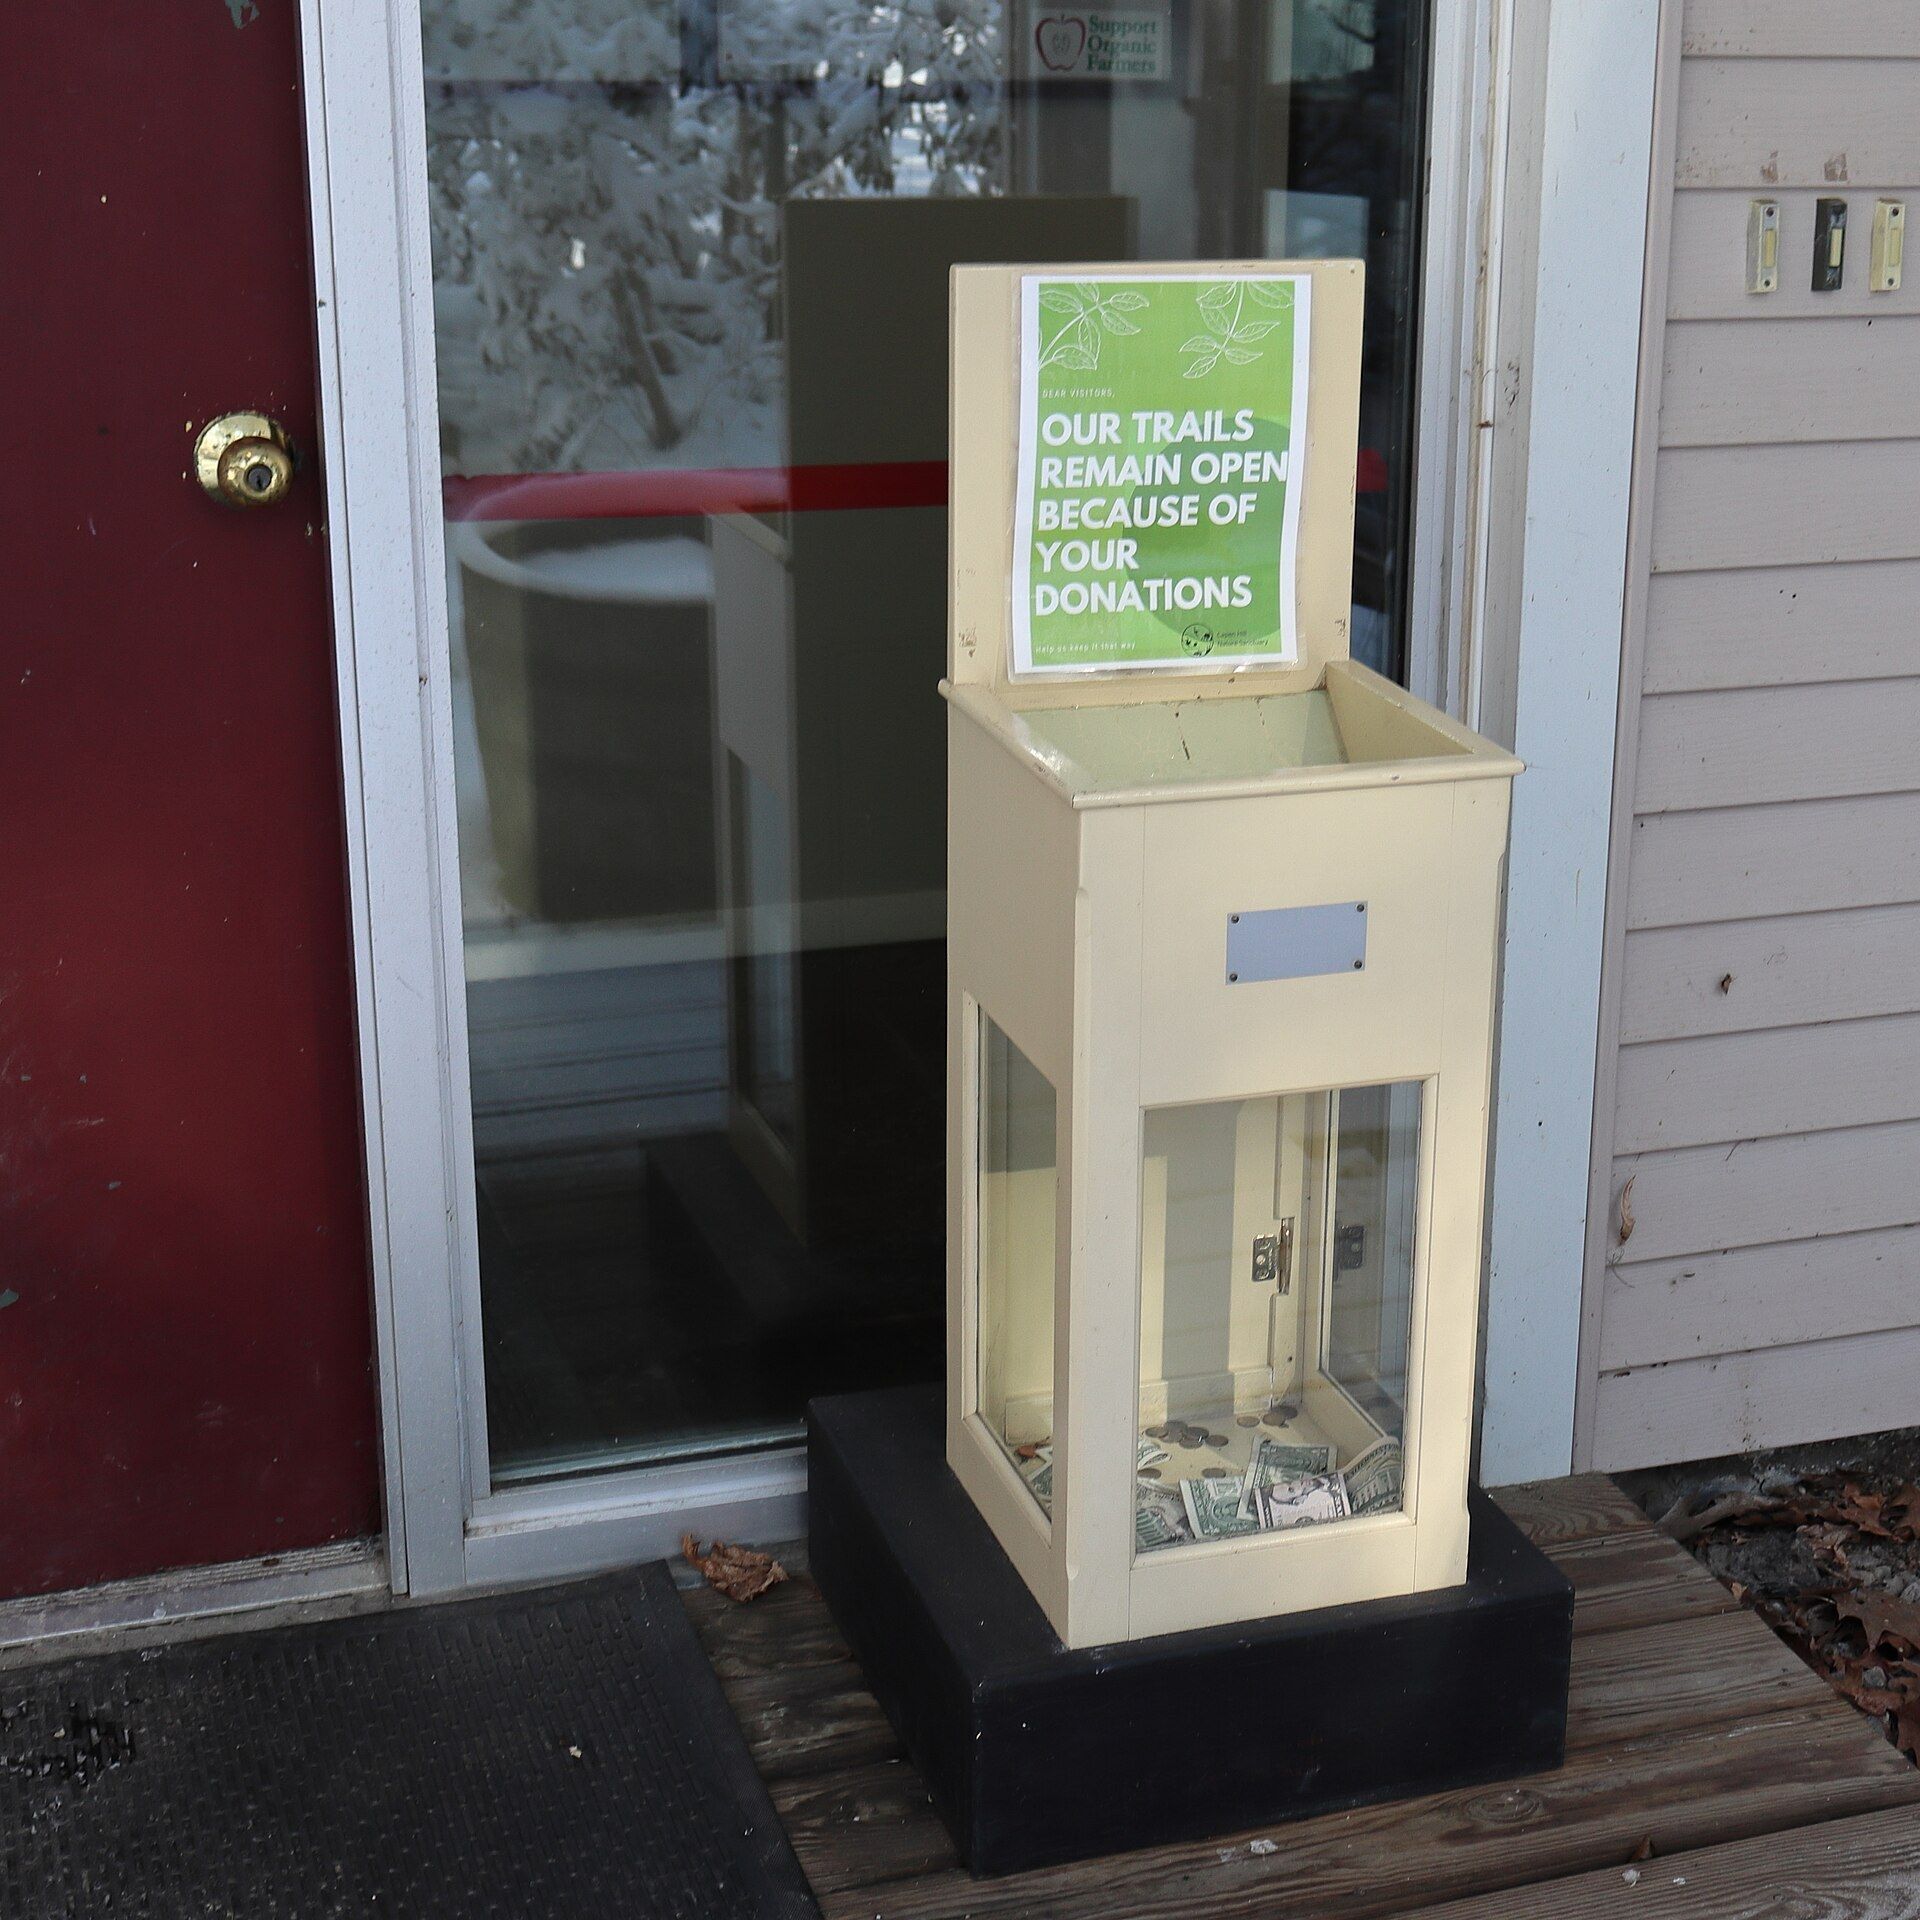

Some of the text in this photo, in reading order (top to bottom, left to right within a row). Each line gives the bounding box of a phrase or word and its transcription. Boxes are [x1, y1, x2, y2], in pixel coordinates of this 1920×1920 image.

[1089, 14, 1156, 37] Support
[1088, 34, 1154, 56] Organic
[1088, 53, 1156, 73] Farmers
[1042, 386, 1115, 399] DEAR VISITORS,
[1042, 409, 1254, 446] OUR TRAILS
[1040, 451, 1288, 489] REMAIN OPEN
[1037, 493, 1258, 531] BECAUSE OF
[1035, 538, 1139, 573] YOUR
[1035, 576, 1253, 615] DONATIONS
